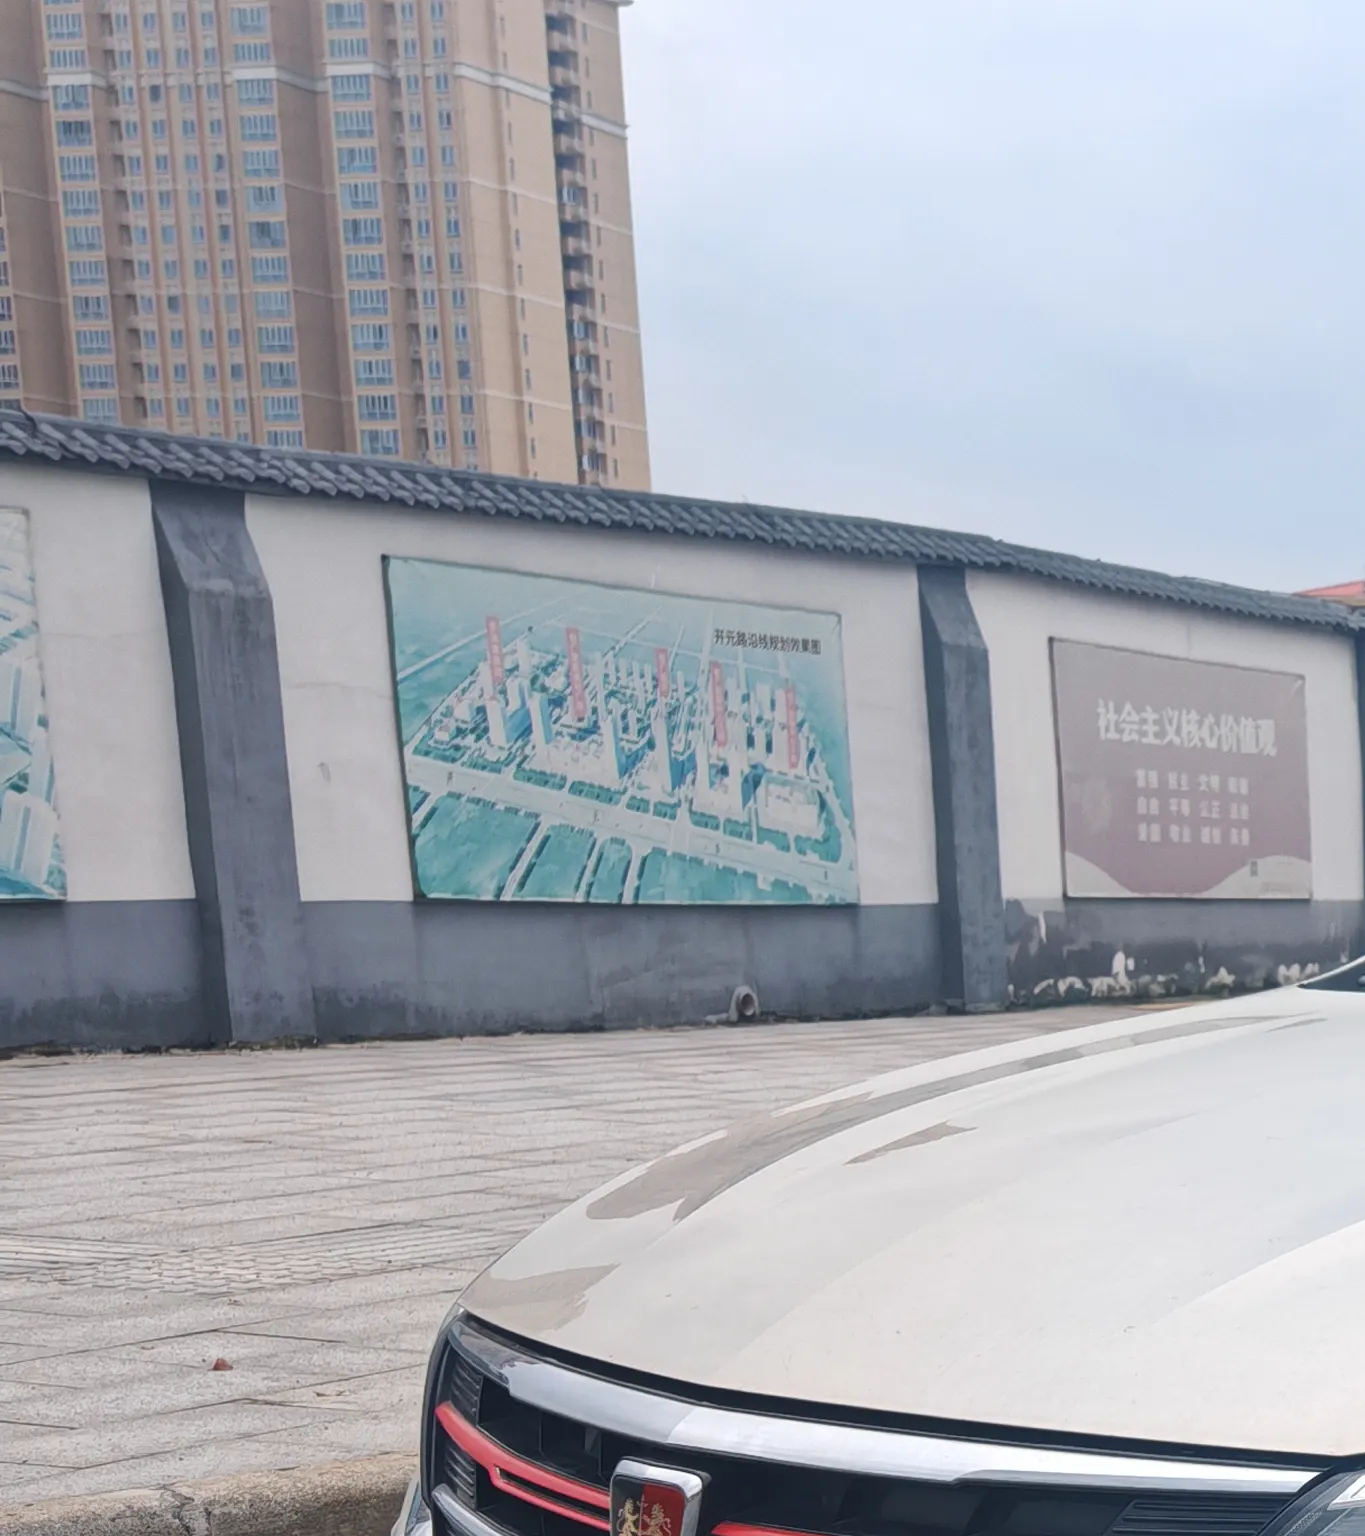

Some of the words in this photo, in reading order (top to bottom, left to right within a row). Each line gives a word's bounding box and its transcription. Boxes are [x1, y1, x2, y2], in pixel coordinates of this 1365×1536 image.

[1096, 698, 1277, 756] 社会主义核心价值观
